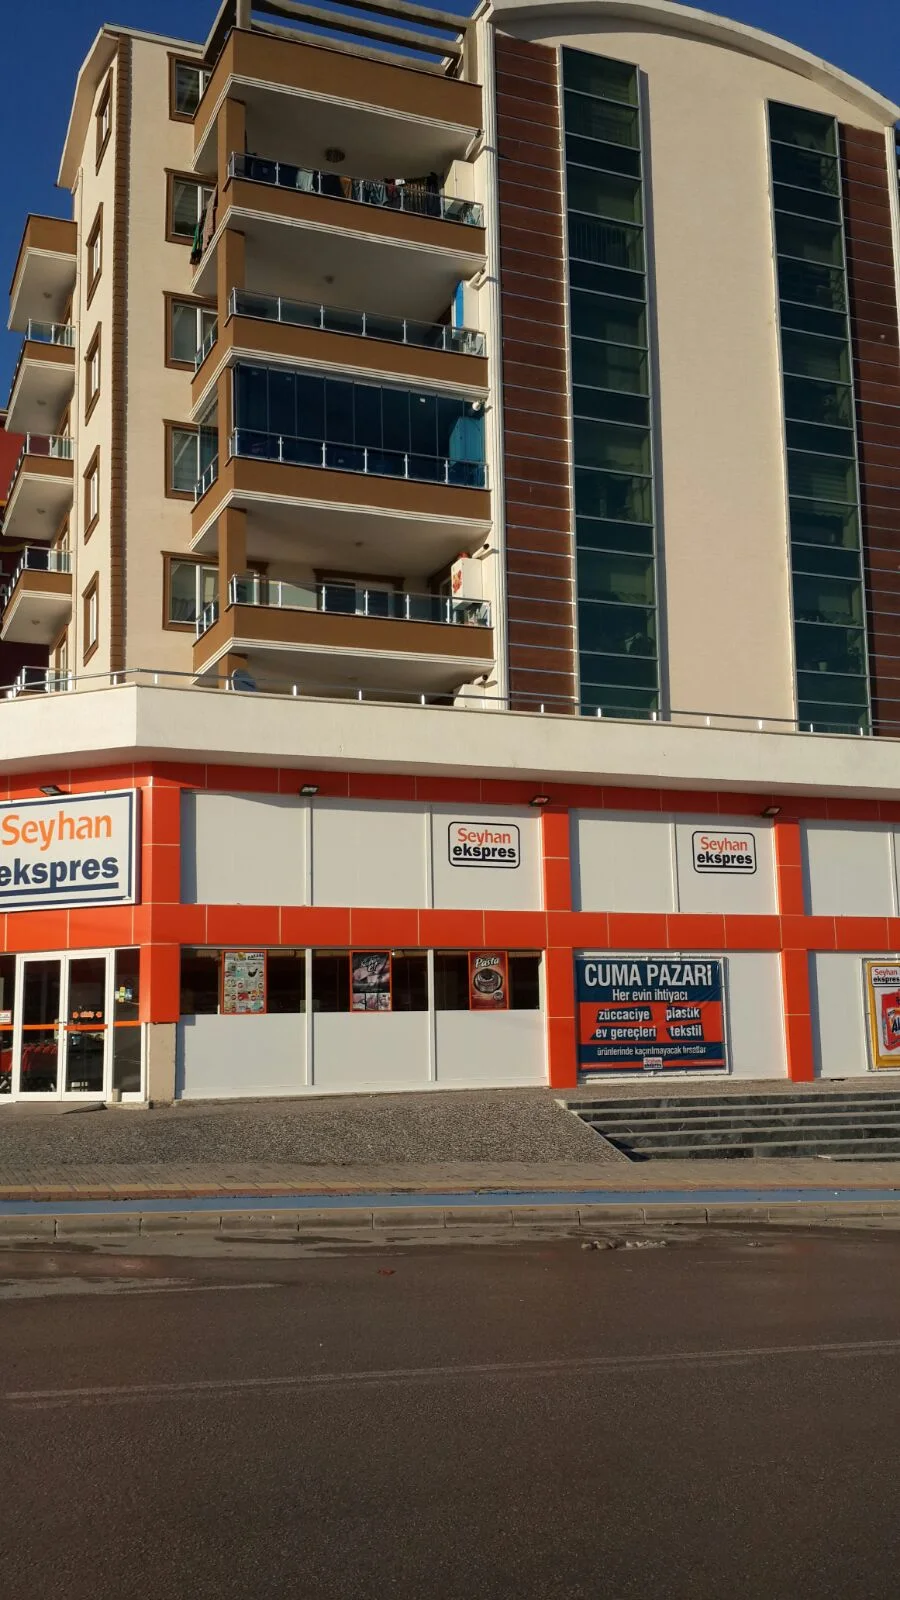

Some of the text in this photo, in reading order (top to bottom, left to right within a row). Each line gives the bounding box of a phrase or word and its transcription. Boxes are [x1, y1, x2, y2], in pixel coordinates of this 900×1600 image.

[1, 810, 112, 851] Seyhan
[457, 827, 511, 846] Seyhan
[452, 843, 516, 860] ekspres
[700, 836, 748, 854] Seyhan
[697, 851, 752, 867] ekspres
[0, 856, 119, 889] ekspres
[584, 964, 712, 987] CUMA PAZARI
[612, 988, 688, 1003] Her evin ihtiyacı
[598, 1008, 650, 1022] züccaciye
[666, 1007, 700, 1021] plastik
[595, 1025, 657, 1040] ev gereçleri
[670, 1025, 702, 1037] tekstil
